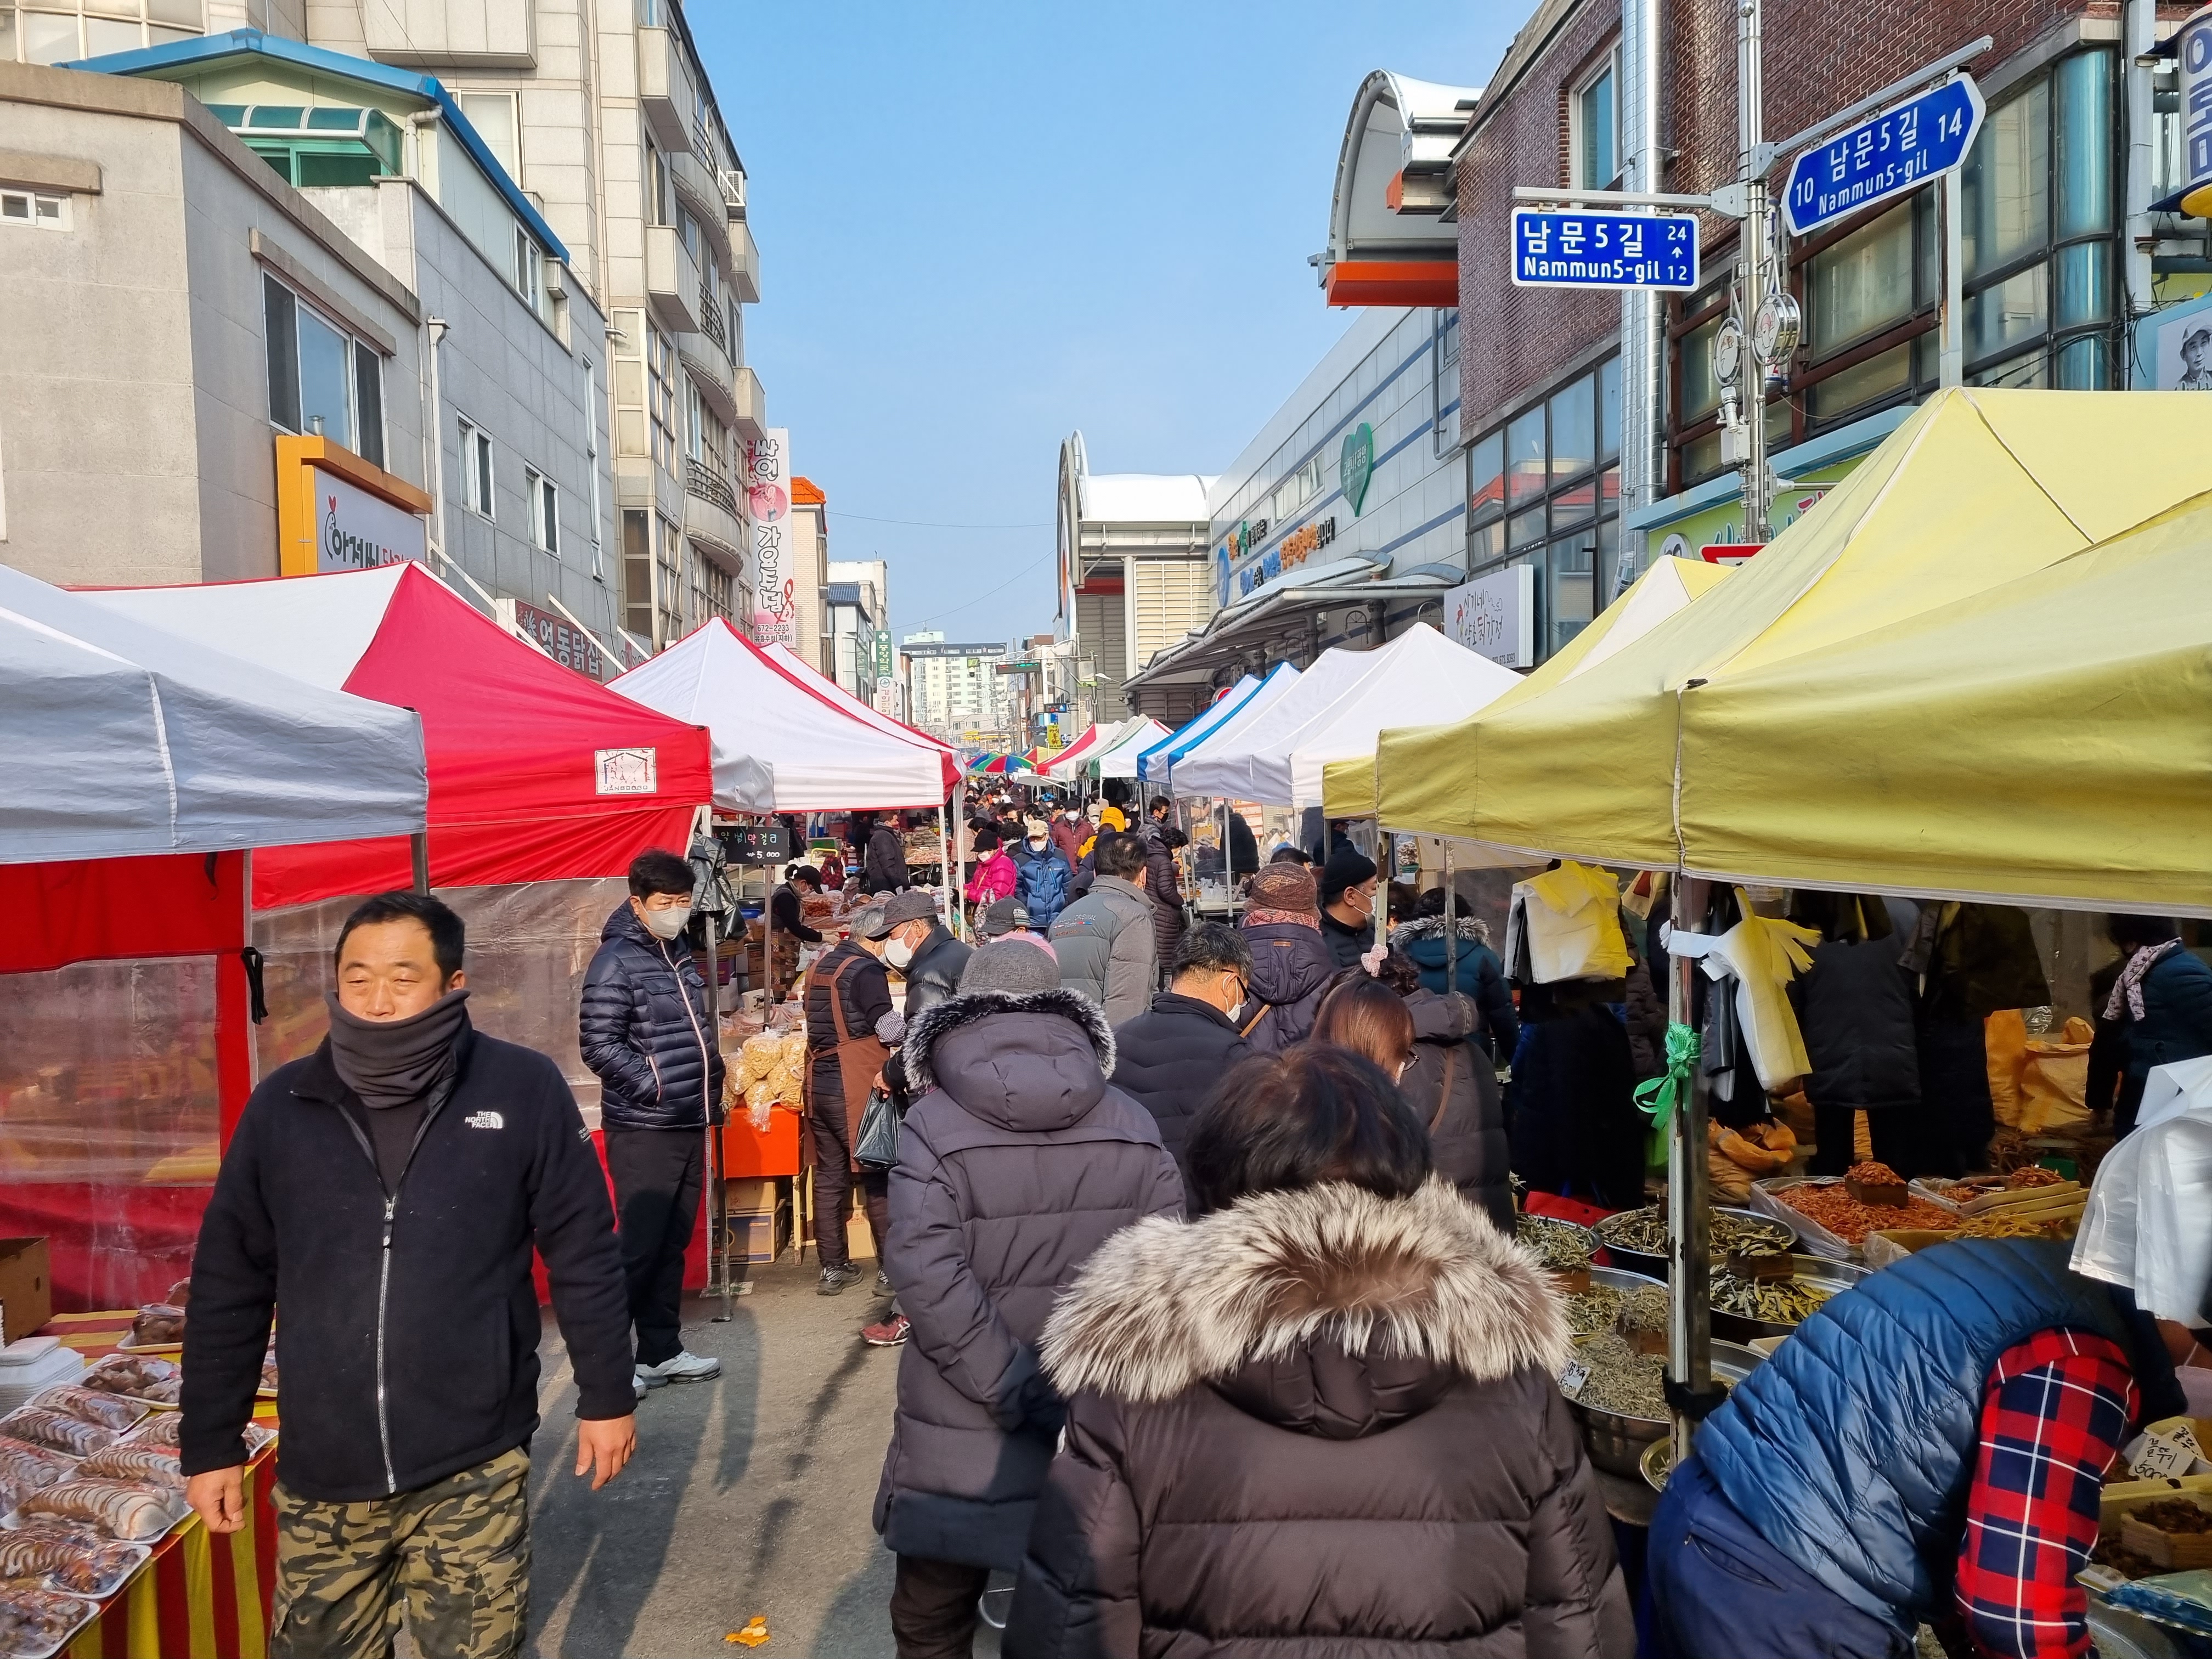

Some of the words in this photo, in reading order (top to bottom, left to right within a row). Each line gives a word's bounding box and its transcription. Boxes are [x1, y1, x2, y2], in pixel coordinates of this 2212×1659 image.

[1938, 107, 1962, 143] 14
[1830, 107, 1918, 182] 남문5길
[1796, 177, 1814, 207] 10
[1819, 149, 1928, 217] Nammun5-gil
[1524, 221, 1643, 257] 남문5길
[1668, 225, 1687, 241] 24
[1524, 256, 1660, 283] Nammun5-gil
[1668, 266, 1687, 280] 12
[878, 644, 889, 672] 중앙약국
